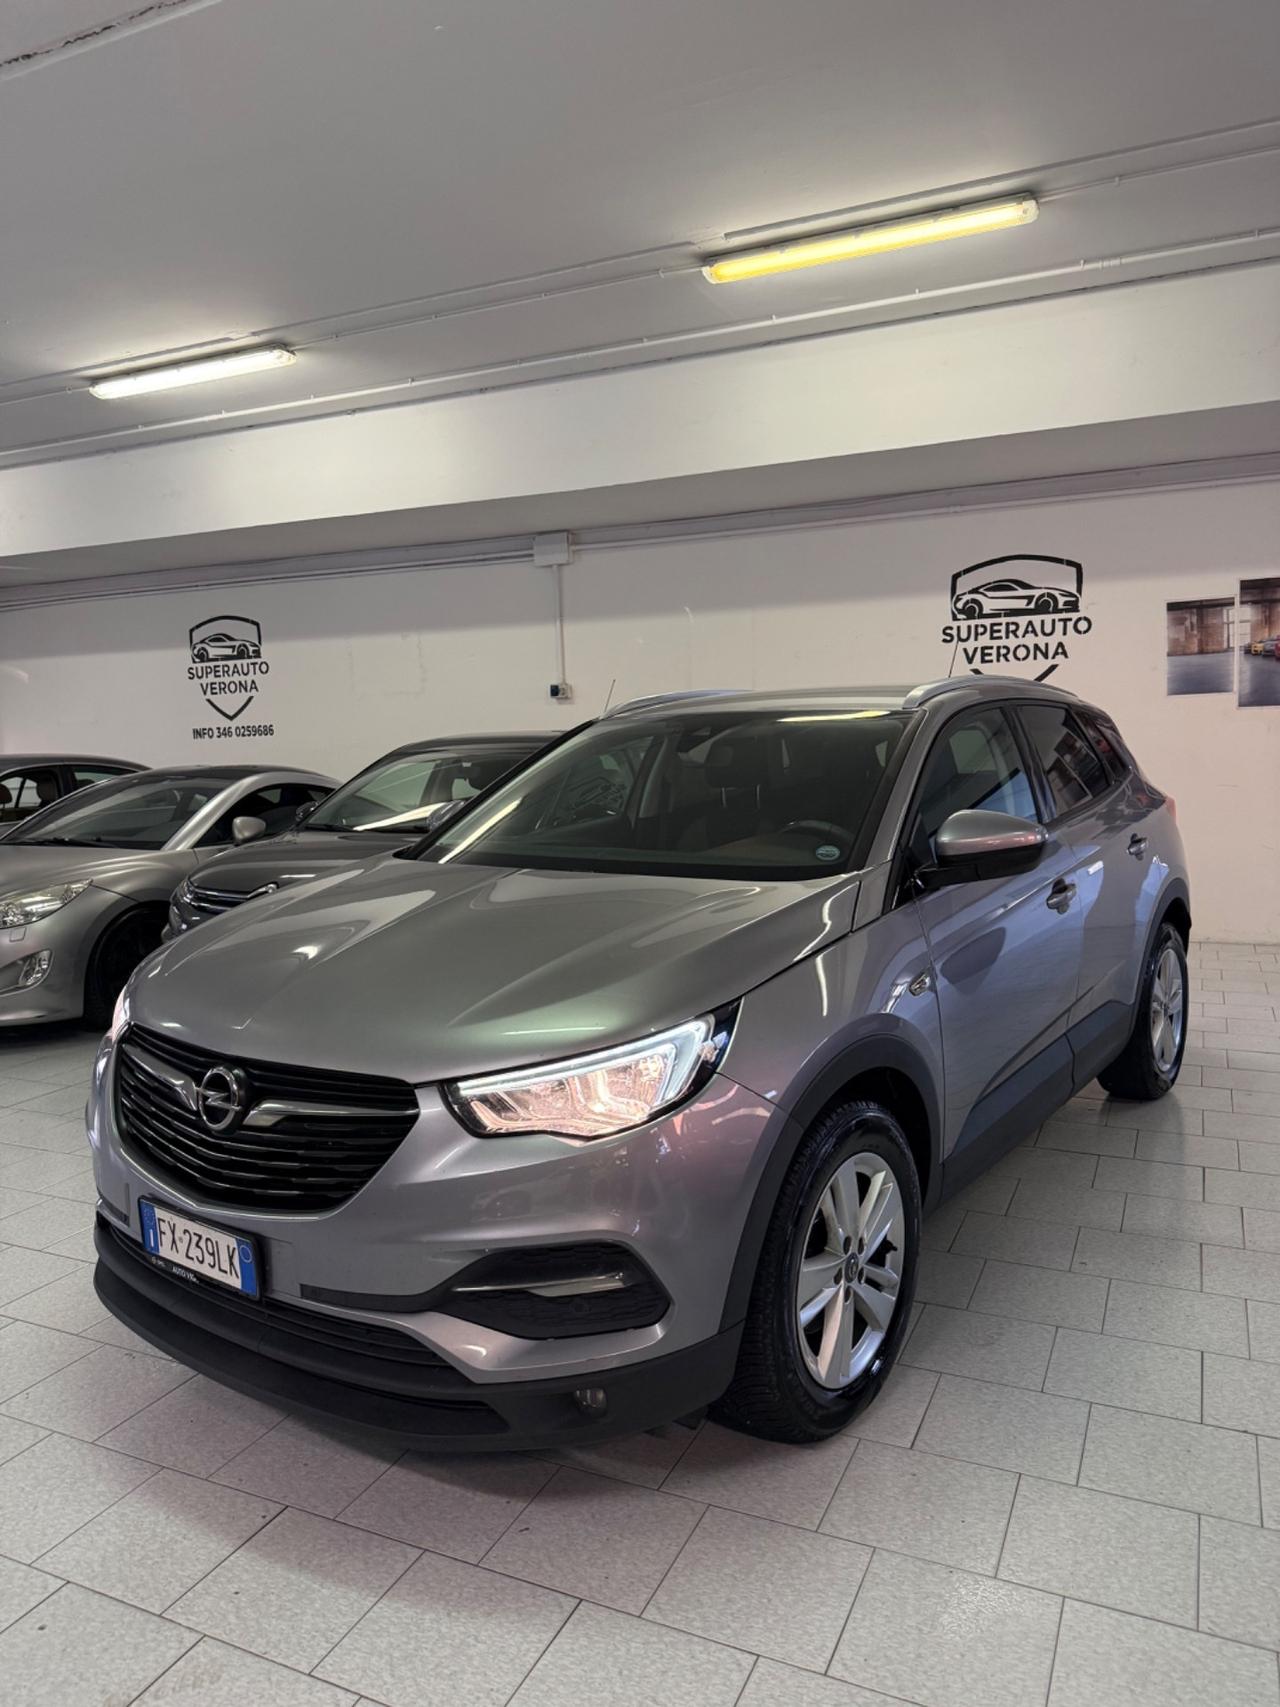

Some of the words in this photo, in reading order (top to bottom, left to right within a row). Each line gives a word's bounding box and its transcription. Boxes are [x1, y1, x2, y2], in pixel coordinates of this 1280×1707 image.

[941, 615, 1093, 644] SUPERAUTO
[962, 641, 1069, 665] VERONA
[187, 660, 270, 680] SUPERAUTO
[200, 679, 259, 696] VERONA
[192, 727, 214, 740] INFO
[216, 726, 233, 739] 346
[234, 724, 275, 738] 0259686
